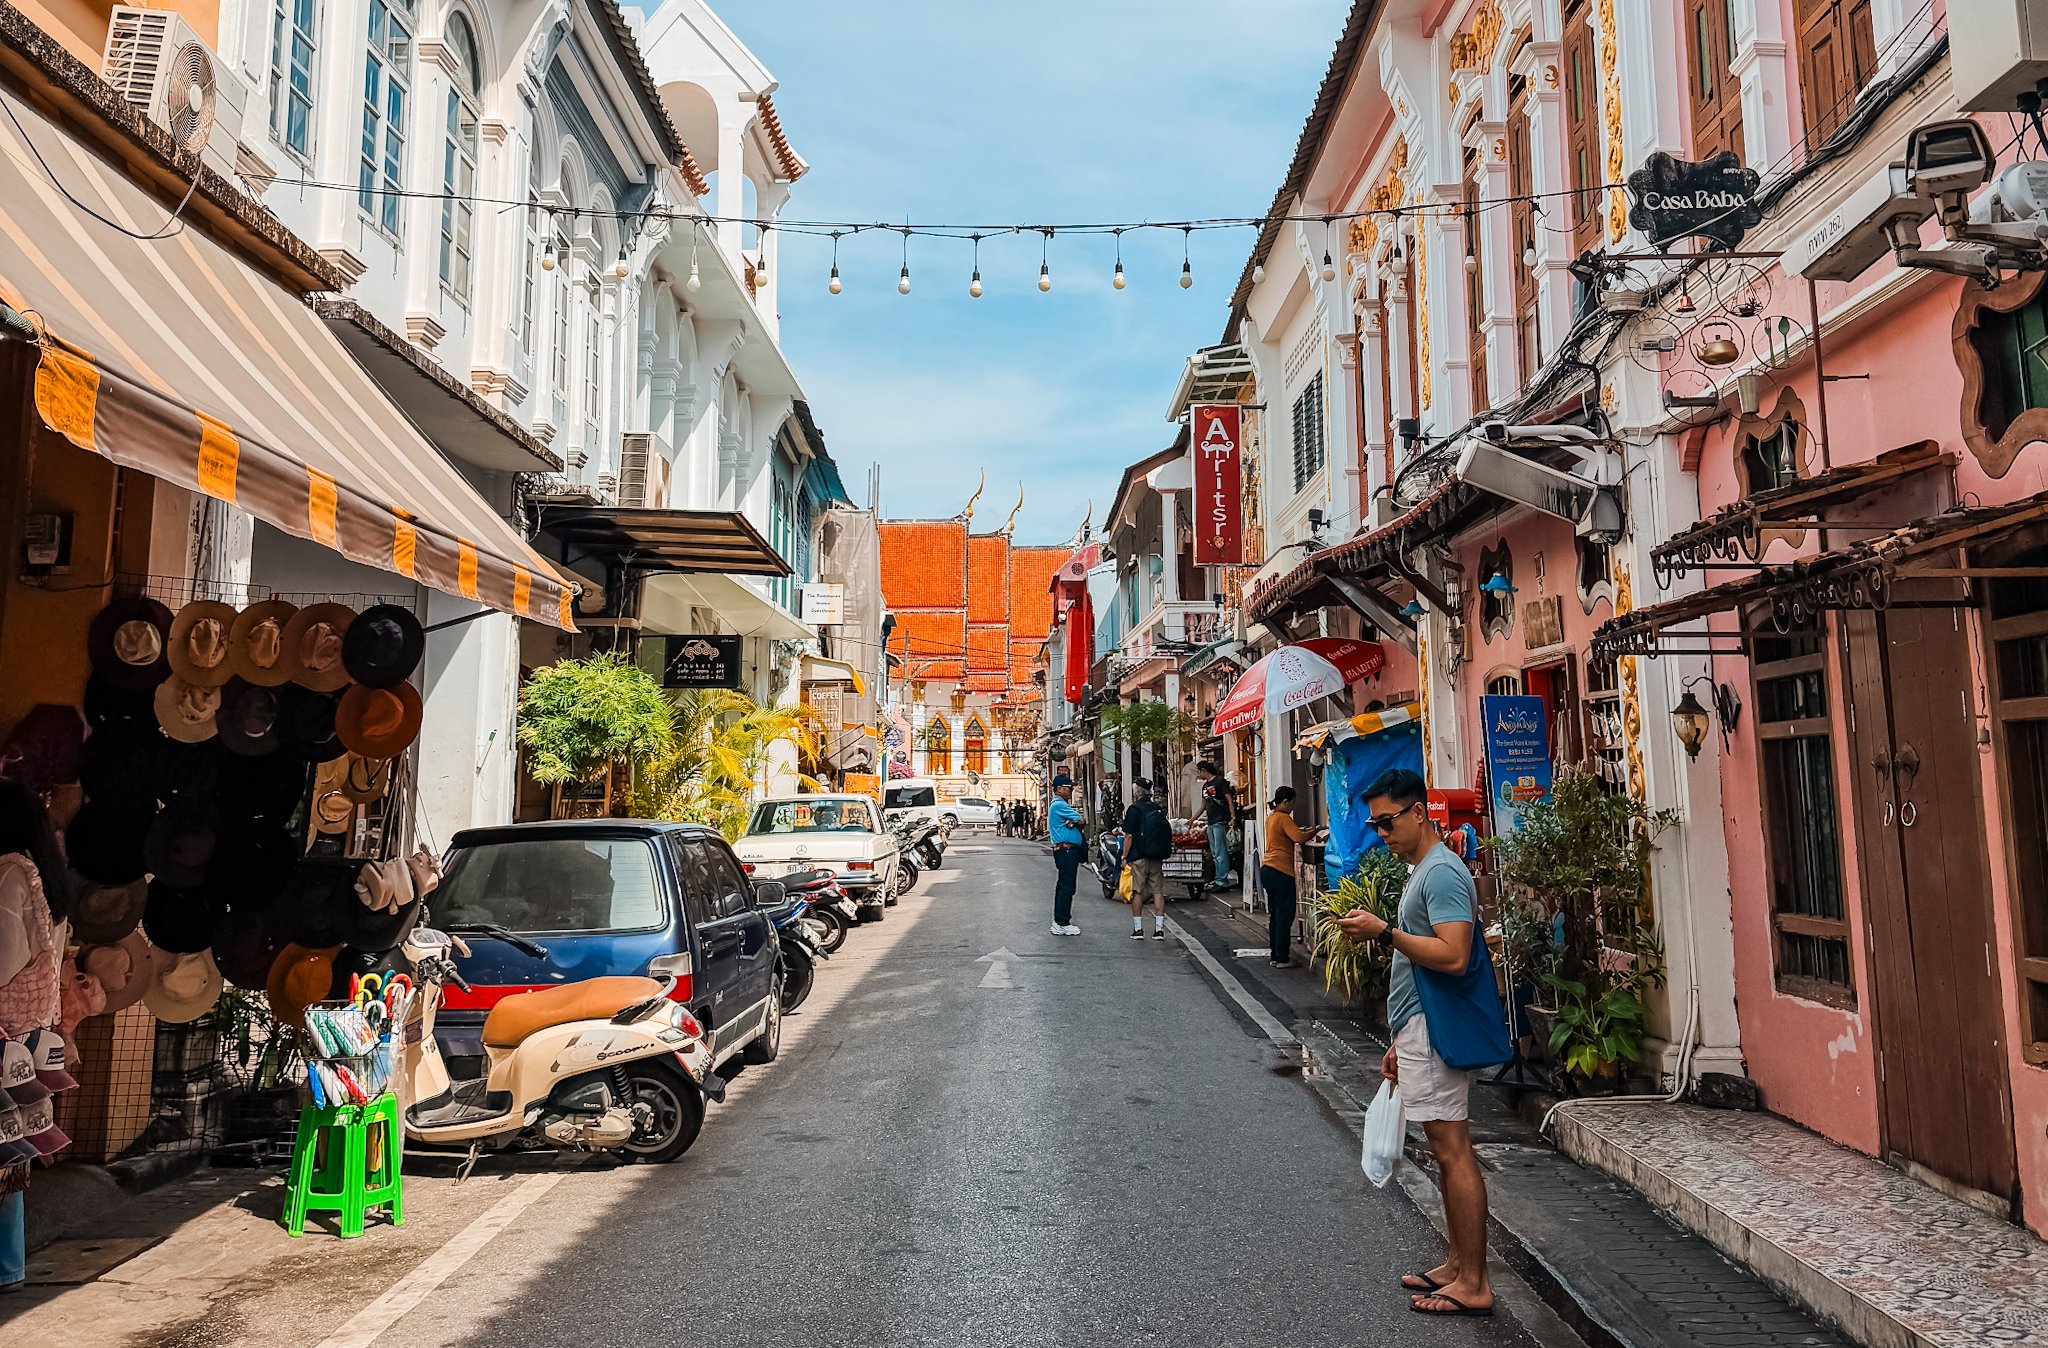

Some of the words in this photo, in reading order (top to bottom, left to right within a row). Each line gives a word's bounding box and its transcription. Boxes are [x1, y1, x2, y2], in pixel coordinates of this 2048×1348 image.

[1643, 191, 1694, 211] Casa
[1695, 190, 1746, 209] Baba
[1829, 215, 1842, 236] 262
[812, 692, 839, 700] COFFEE
[1284, 675, 1326, 707] Coca-Cola
